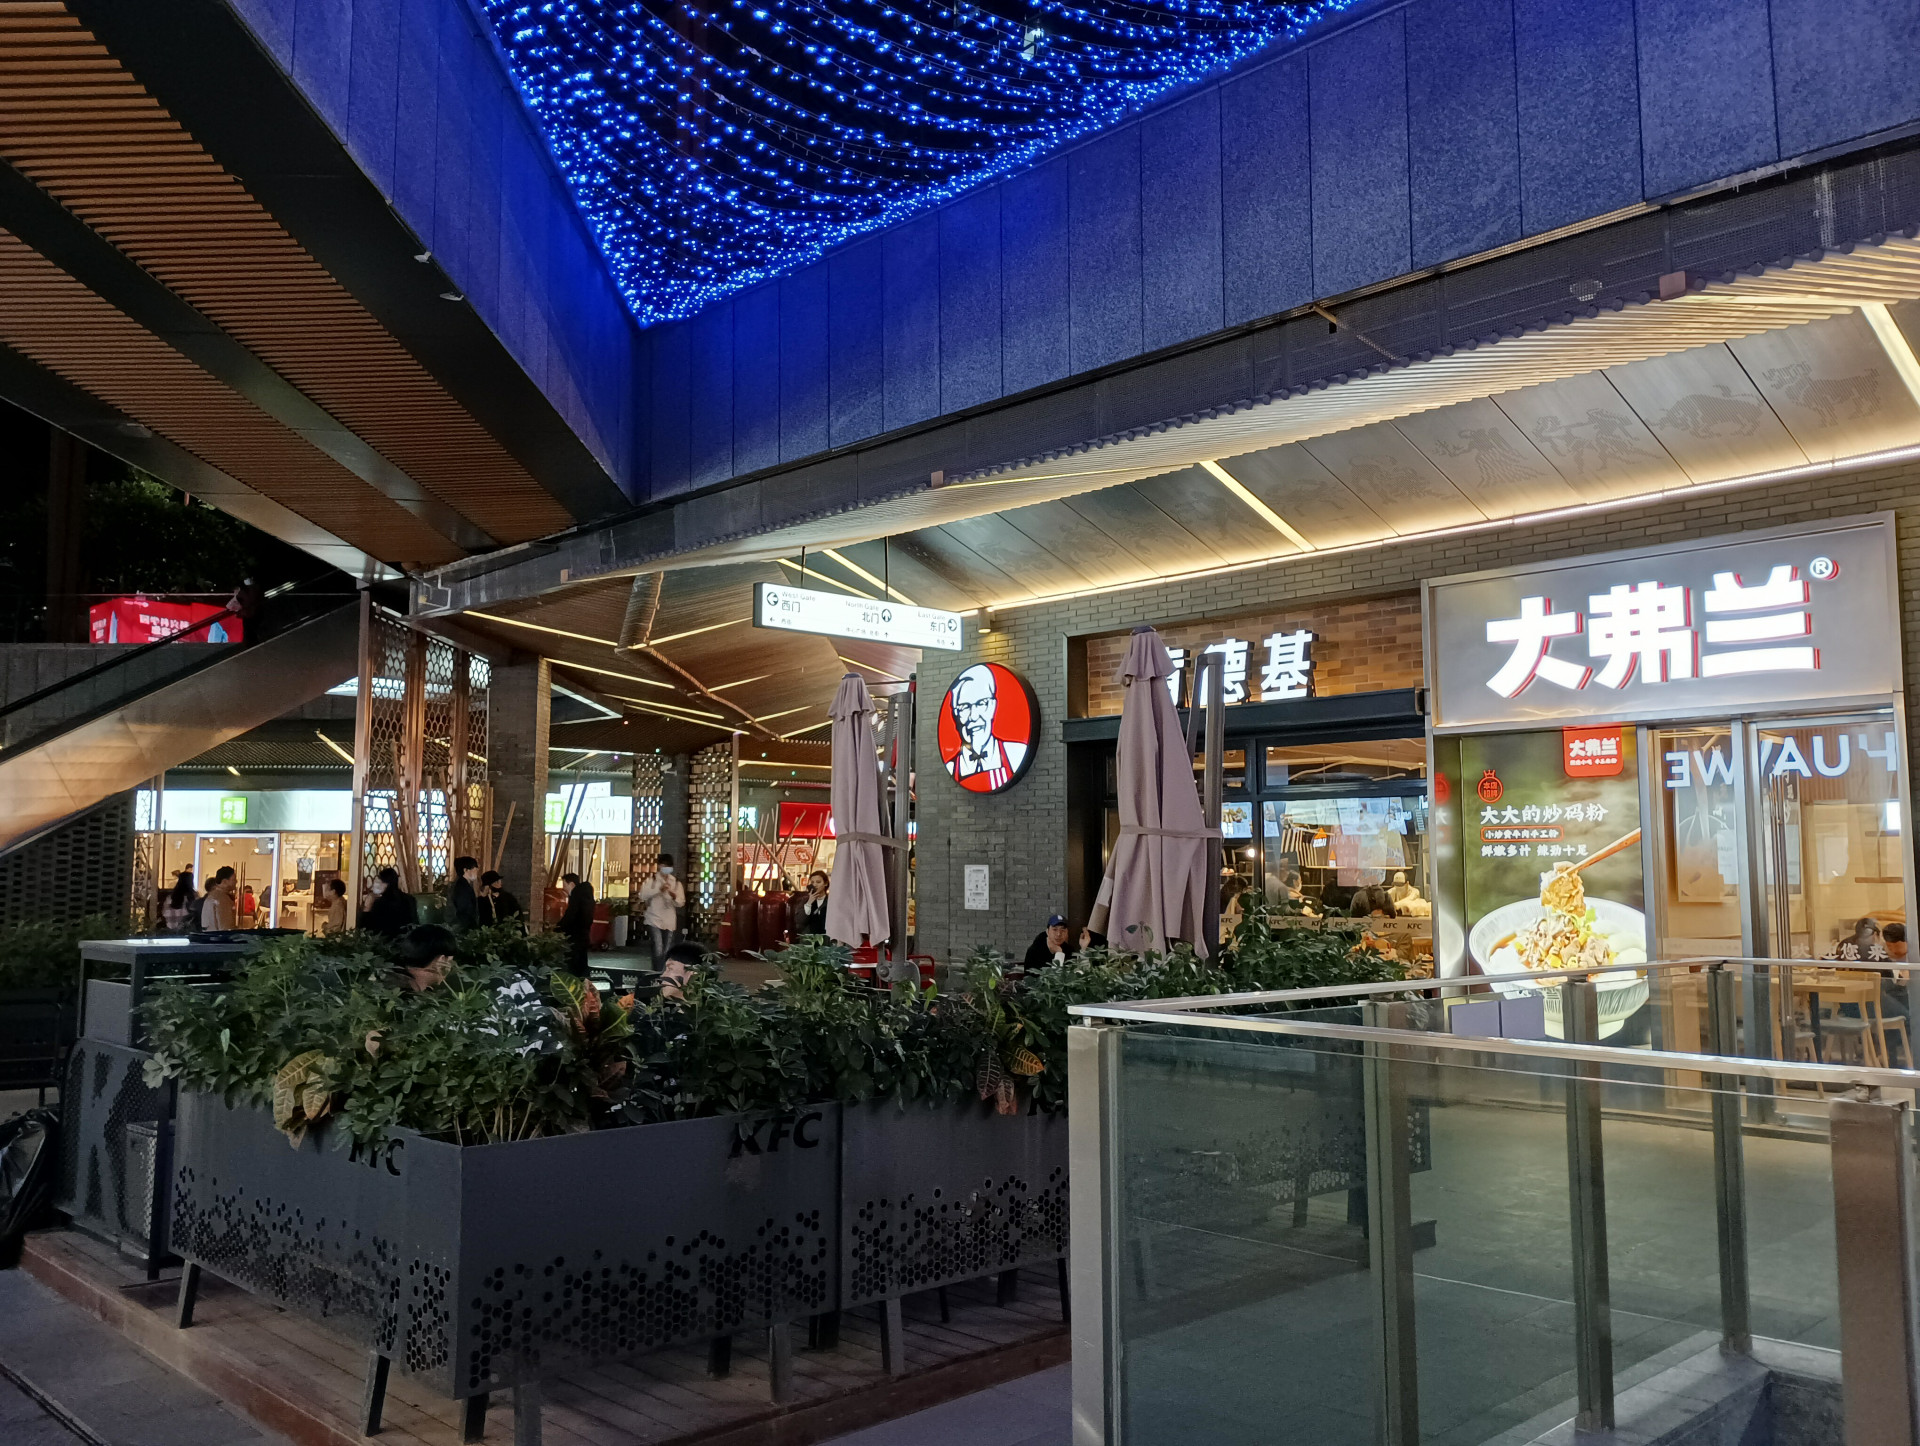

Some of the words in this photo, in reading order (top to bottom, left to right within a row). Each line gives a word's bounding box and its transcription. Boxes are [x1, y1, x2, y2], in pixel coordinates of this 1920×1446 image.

[781, 591, 799, 599] West
[781, 600, 801, 613] 西门
[845, 600, 864, 609] North
[864, 603, 880, 611] Gate
[862, 611, 880, 625] 北门
[917, 611, 932, 619] East
[930, 621, 947, 633] 东门
[1485, 565, 1820, 698] 大弗兰
[1569, 737, 1618, 758] 大弗兰
[1480, 803, 1609, 825] 大大的炒码粉
[1485, 829, 1560, 839] 小炒黄牛肉手工粉
[1481, 844, 1531, 857] 鲜嫩多汁
[727, 1111, 823, 1159] KFC
